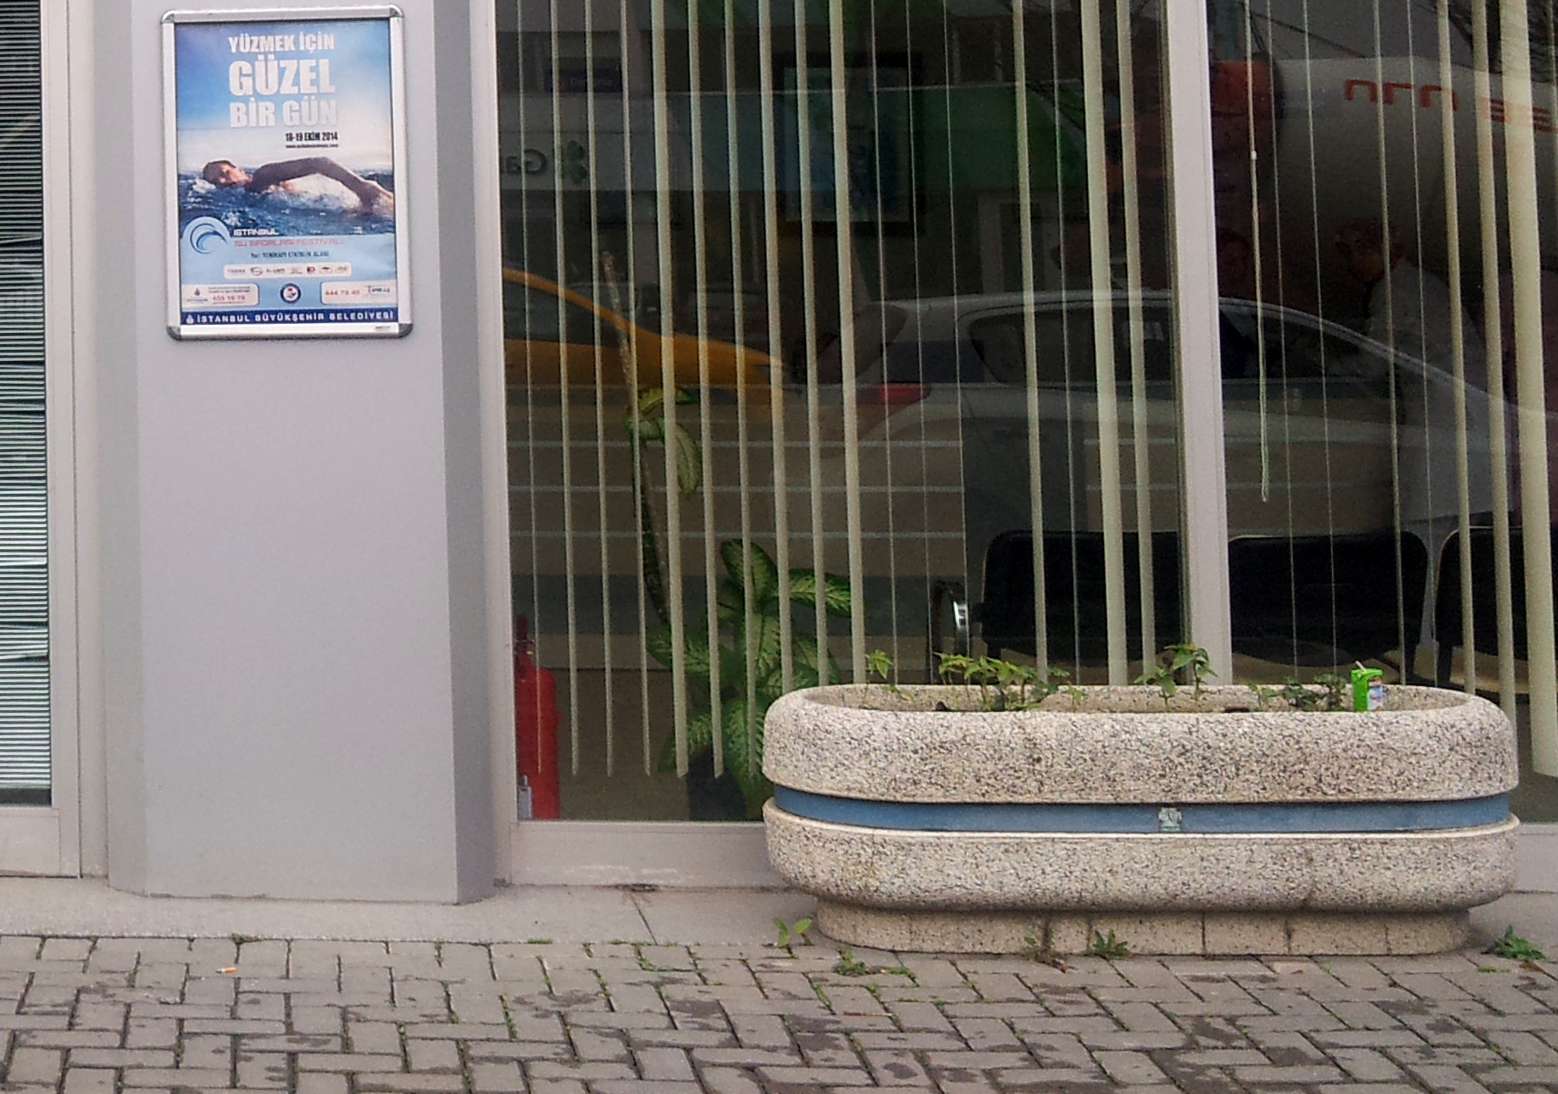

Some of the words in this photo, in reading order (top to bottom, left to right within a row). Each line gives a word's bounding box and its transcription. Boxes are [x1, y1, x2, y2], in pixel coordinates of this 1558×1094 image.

[228, 33, 295, 55] YÜZMEK
[298, 31, 335, 53] İÇİN
[228, 55, 336, 97] GÜZEL
[229, 98, 276, 128] BİR
[282, 95, 338, 126] GÜN
[322, 131, 339, 141] 2014
[197, 314, 250, 323] İSTANBUL
[254, 311, 324, 322] BÜYÜKŞEHİR
[329, 310, 394, 321] BELEDİYESİ
